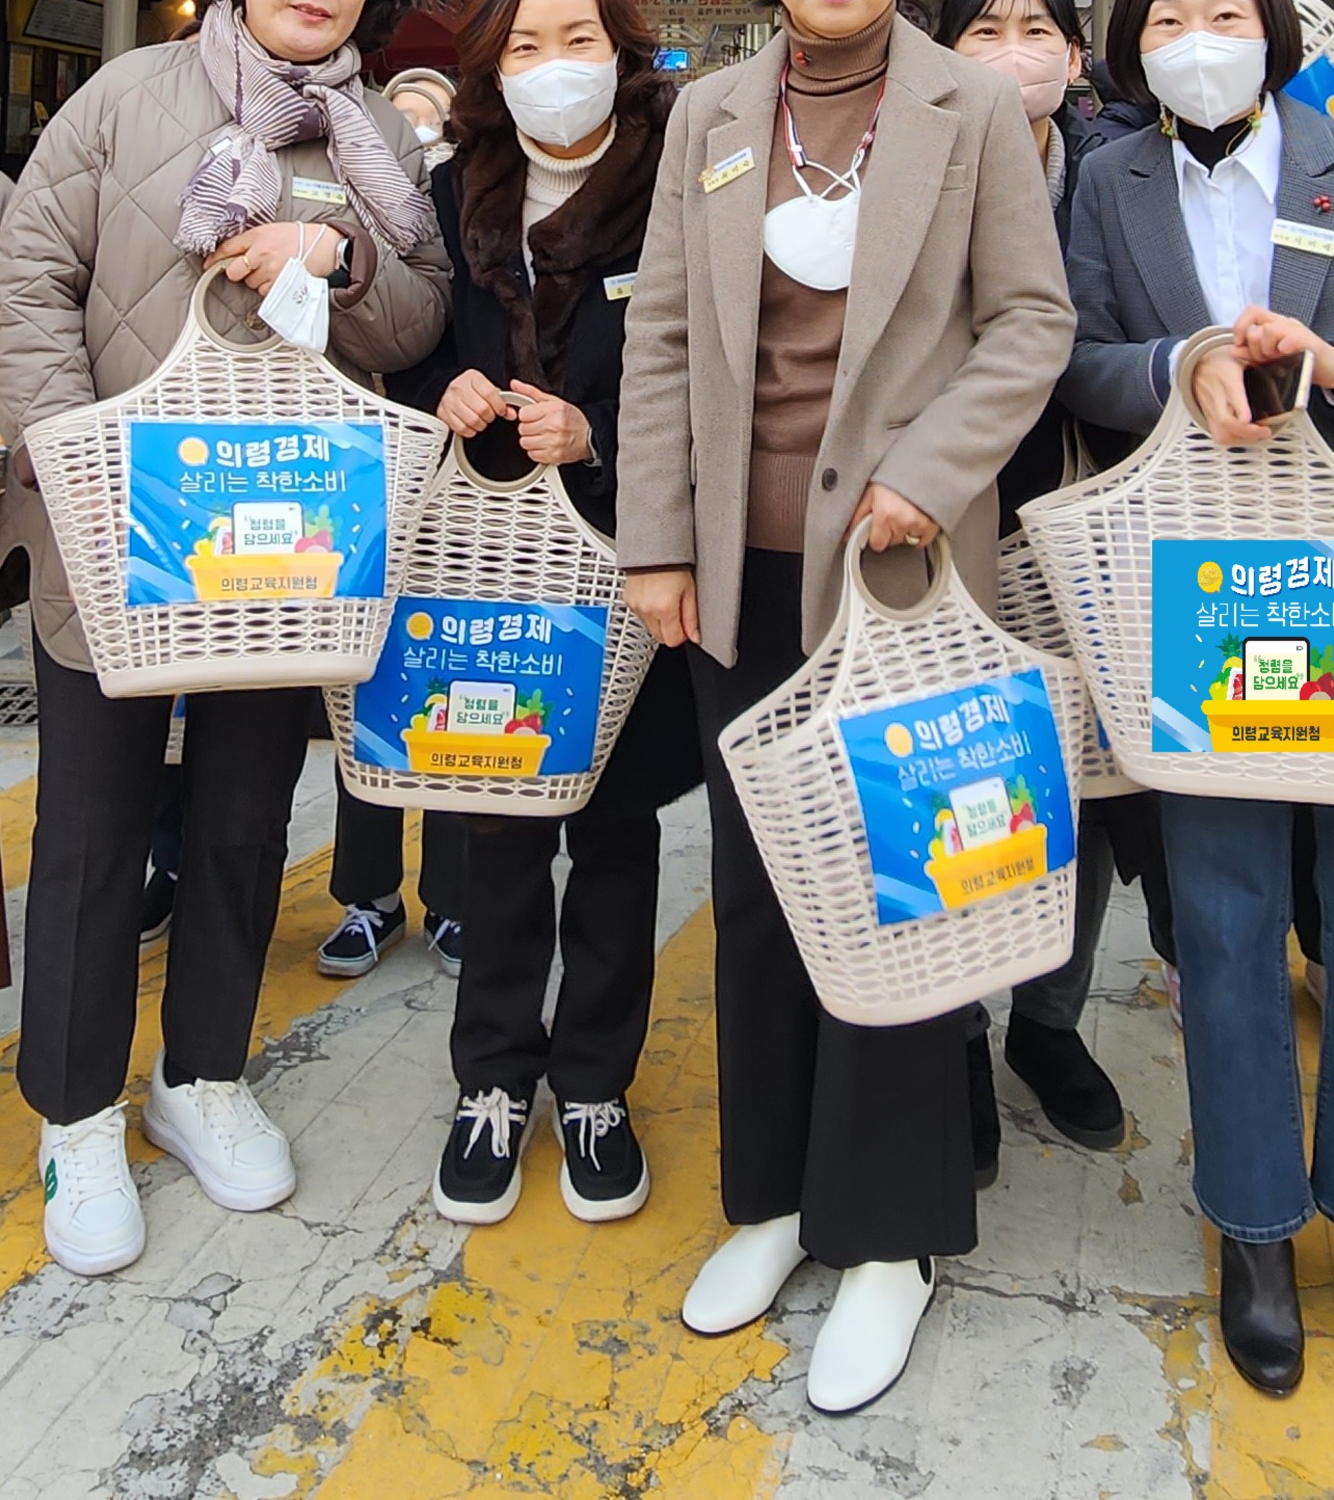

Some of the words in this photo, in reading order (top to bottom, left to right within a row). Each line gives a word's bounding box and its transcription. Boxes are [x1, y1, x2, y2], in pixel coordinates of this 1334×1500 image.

[215, 434, 330, 469] 의령경제
[179, 471, 249, 493] 살리는
[256, 469, 347, 493] 착한소비
[440, 613, 552, 646] 의령경제
[1196, 601, 1260, 628] 살리는
[403, 646, 468, 671] 살리는
[475, 649, 563, 676] 착한소비
[914, 694, 1011, 751] 의령경제
[430, 753, 523, 770] 의령교육지원청
[898, 756, 956, 792] 살리는
[957, 731, 1032, 771] 착한소비
